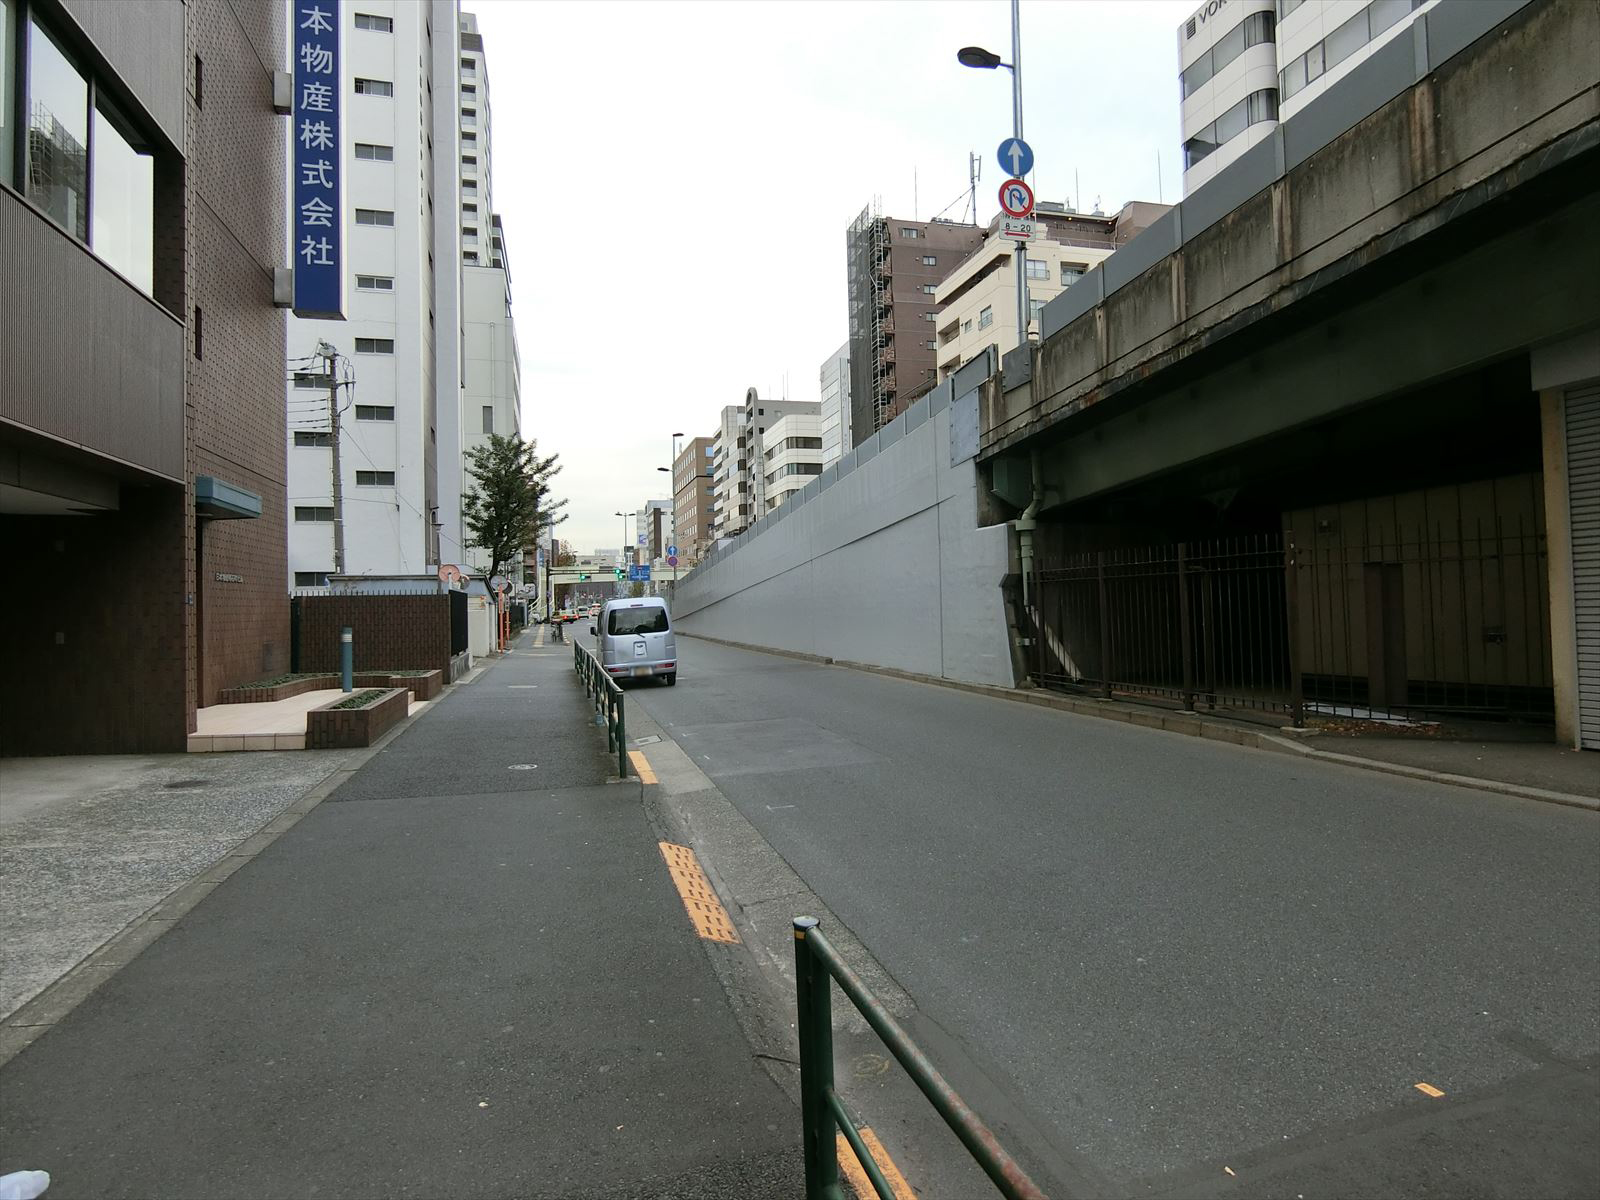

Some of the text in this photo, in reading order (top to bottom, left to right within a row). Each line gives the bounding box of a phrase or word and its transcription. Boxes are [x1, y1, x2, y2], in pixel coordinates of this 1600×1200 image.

[300, 5, 334, 266] 本物産株式会社
